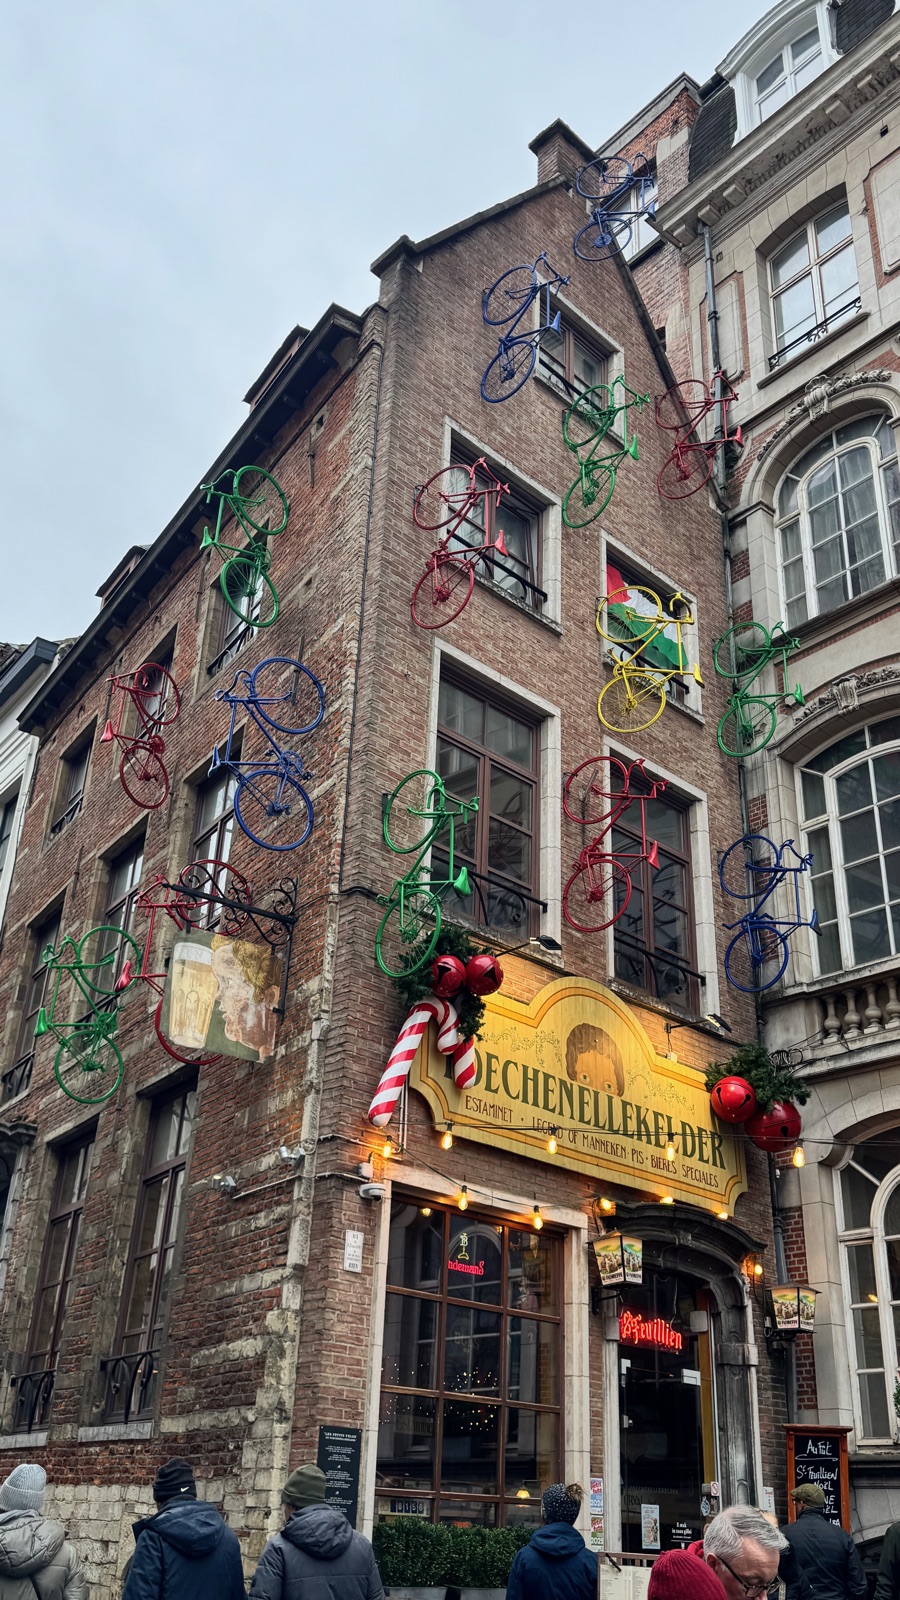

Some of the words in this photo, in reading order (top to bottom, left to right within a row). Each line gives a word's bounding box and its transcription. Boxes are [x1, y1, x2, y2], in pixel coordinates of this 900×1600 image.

[444, 1047, 726, 1170] ECHENELLEKELDER
[465, 1095, 513, 1123] ESTAMINET
[568, 1129, 579, 1144] OF
[582, 1133, 627, 1160] MANNEKEN
[631, 1148, 645, 1165] PIS
[651, 1154, 678, 1175] BIERES
[681, 1164, 719, 1188] SPECIALES
[806, 1439, 817, 1454] Au
[397, 1502, 425, 1512] 8156
